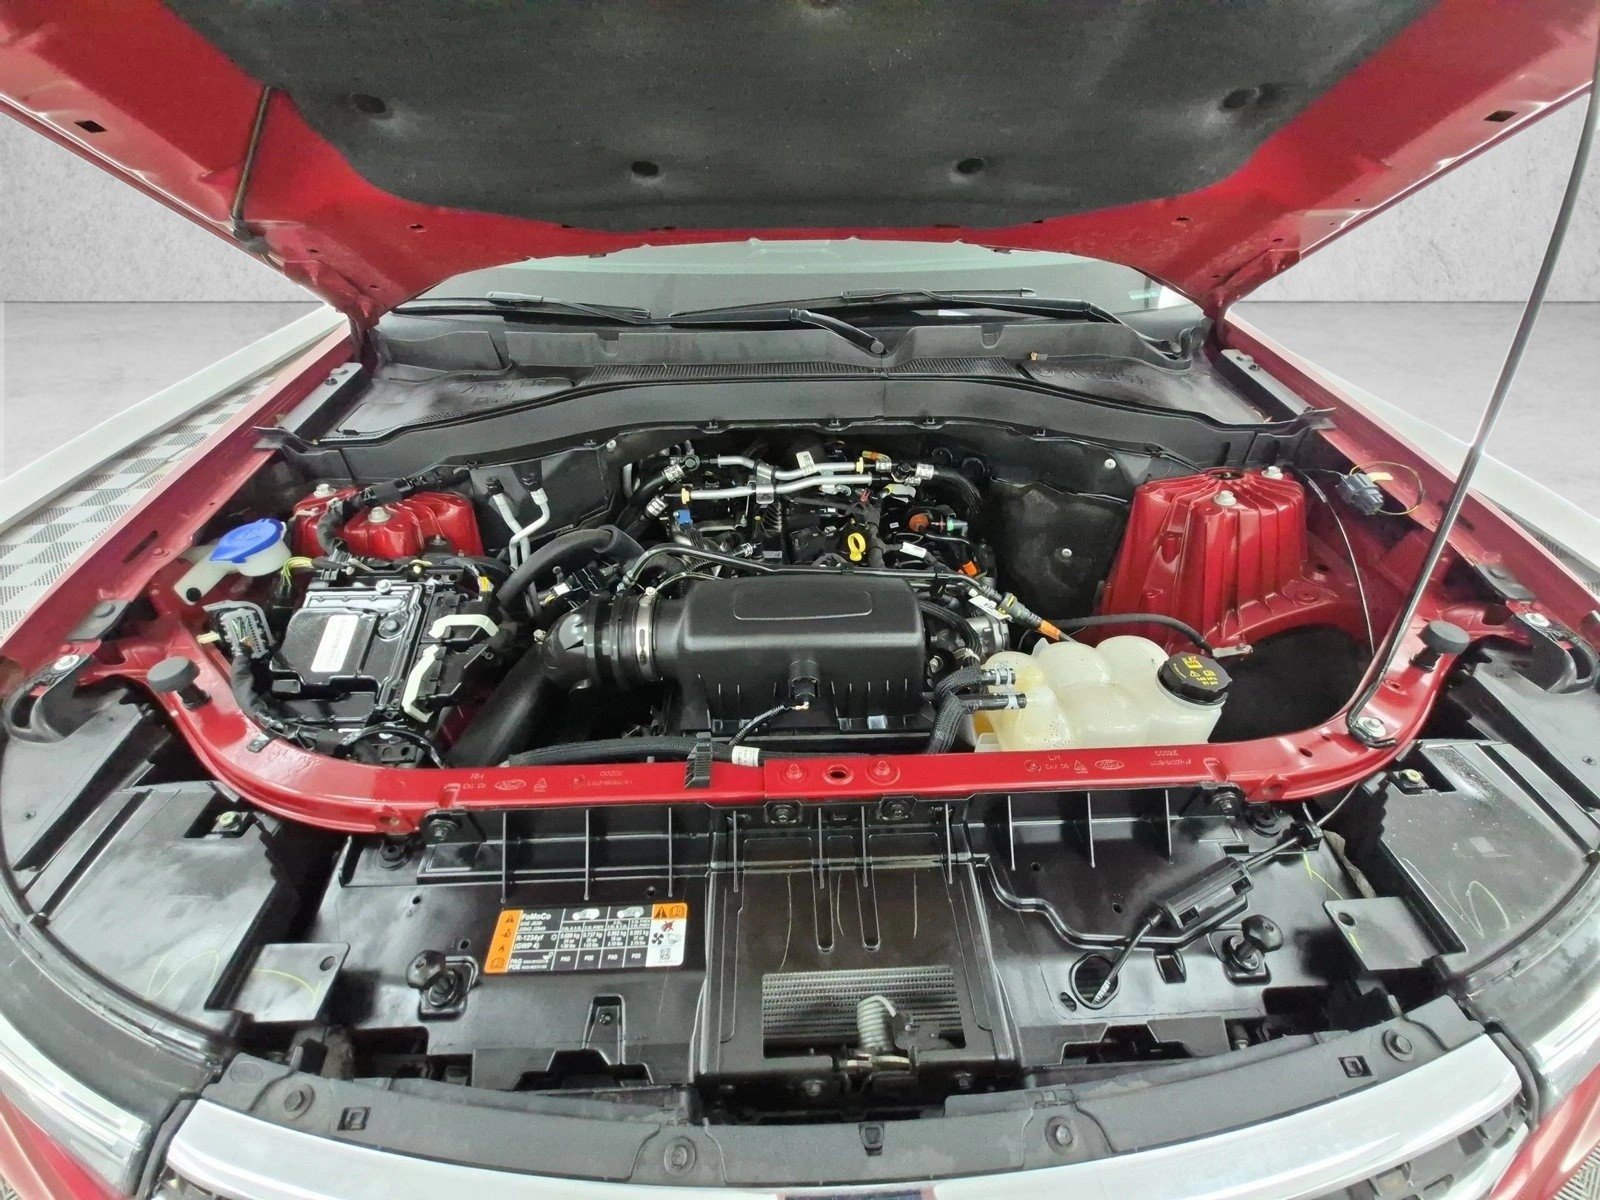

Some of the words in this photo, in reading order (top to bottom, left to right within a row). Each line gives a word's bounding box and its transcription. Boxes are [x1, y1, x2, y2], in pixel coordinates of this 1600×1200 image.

[522, 912, 552, 921] FoMoCo
[516, 934, 544, 943] R-1234yf
[513, 942, 533, 950] (GWP
